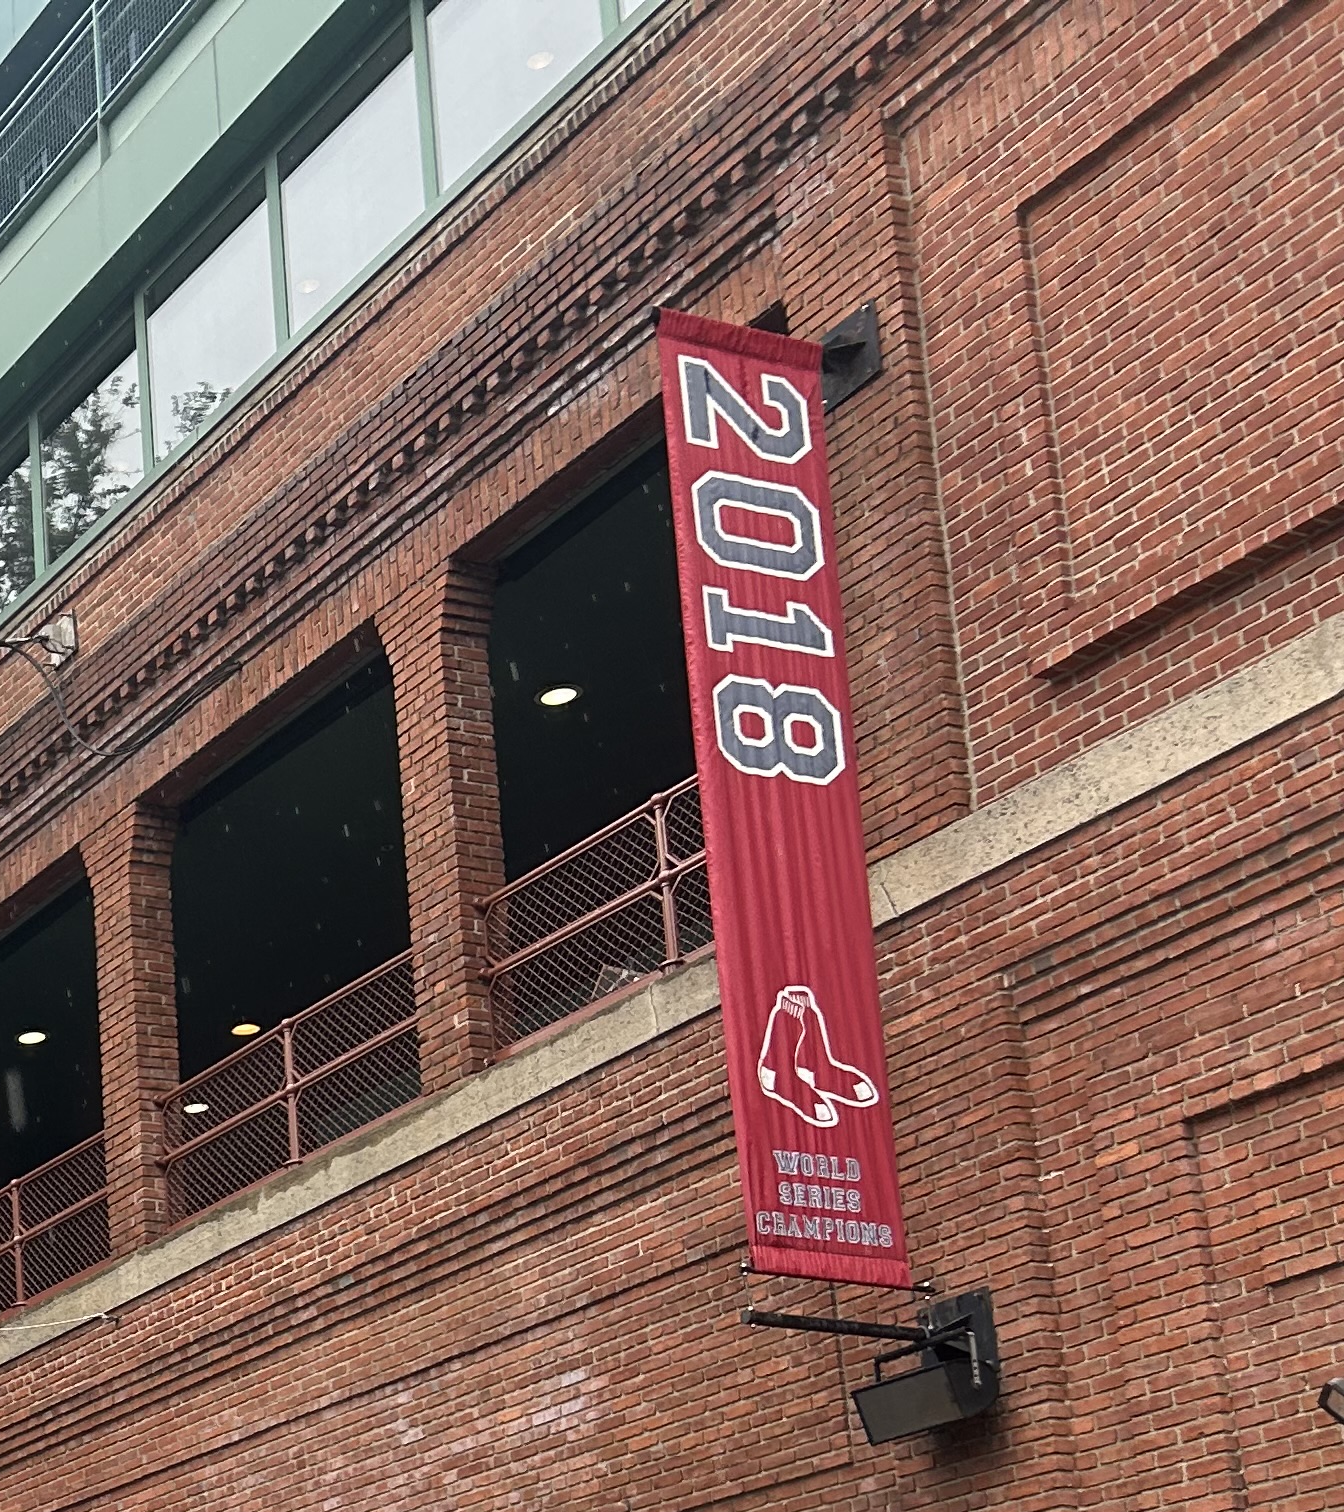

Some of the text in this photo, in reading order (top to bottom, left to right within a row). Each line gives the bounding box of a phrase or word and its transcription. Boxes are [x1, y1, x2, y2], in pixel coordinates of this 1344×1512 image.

[676, 354, 846, 787] 2018
[772, 1148, 861, 1182] WORLD
[777, 1179, 862, 1213] SERIES
[755, 1208, 894, 1249] CHAMPIONS
